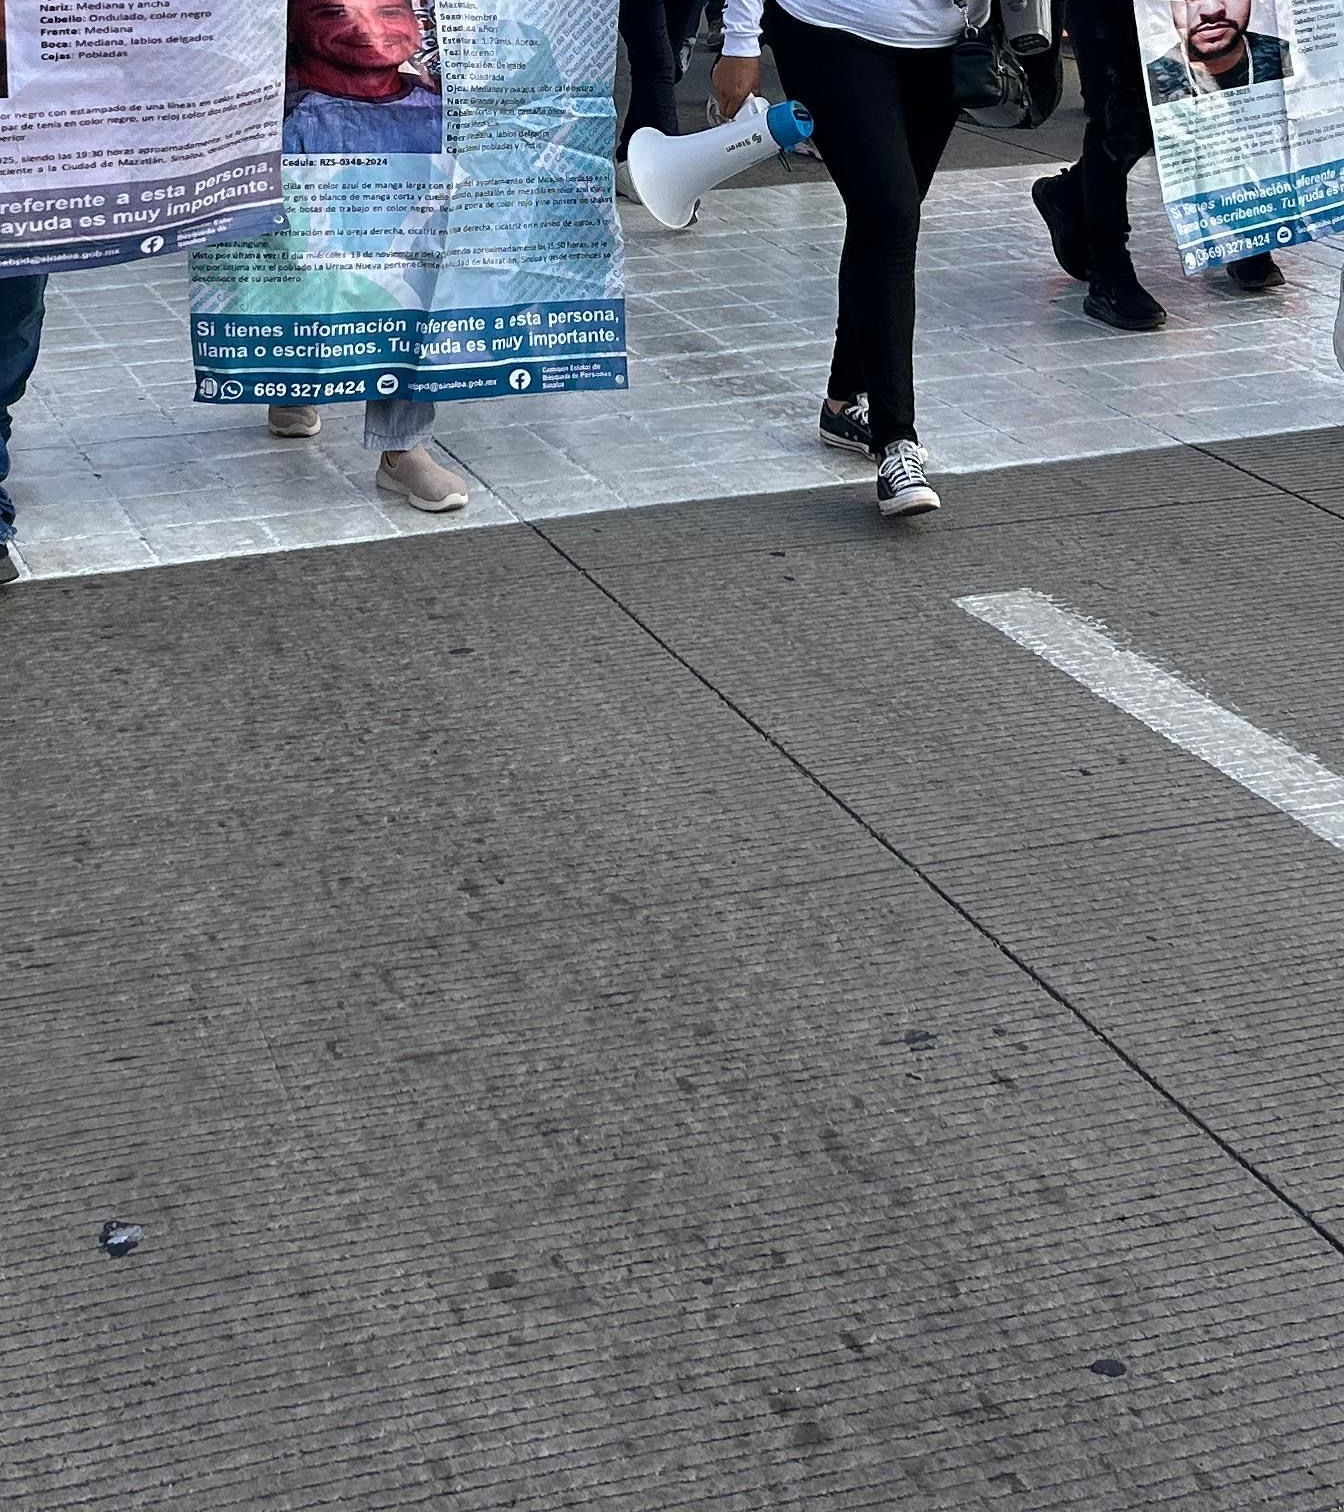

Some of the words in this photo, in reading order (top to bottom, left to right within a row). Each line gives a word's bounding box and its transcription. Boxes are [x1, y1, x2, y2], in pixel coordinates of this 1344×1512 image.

[0, 192, 106, 216] referente
[116, 192, 130, 205] a
[140, 183, 186, 203] esta
[194, 159, 275, 196] persona,
[0, 214, 72, 238] ayuda
[79, 213, 106, 229] es
[112, 204, 161, 226] muy
[166, 179, 275, 217] importante.
[254, 383, 287, 397] 669
[290, 382, 323, 398] 327
[325, 379, 367, 396] 8424
